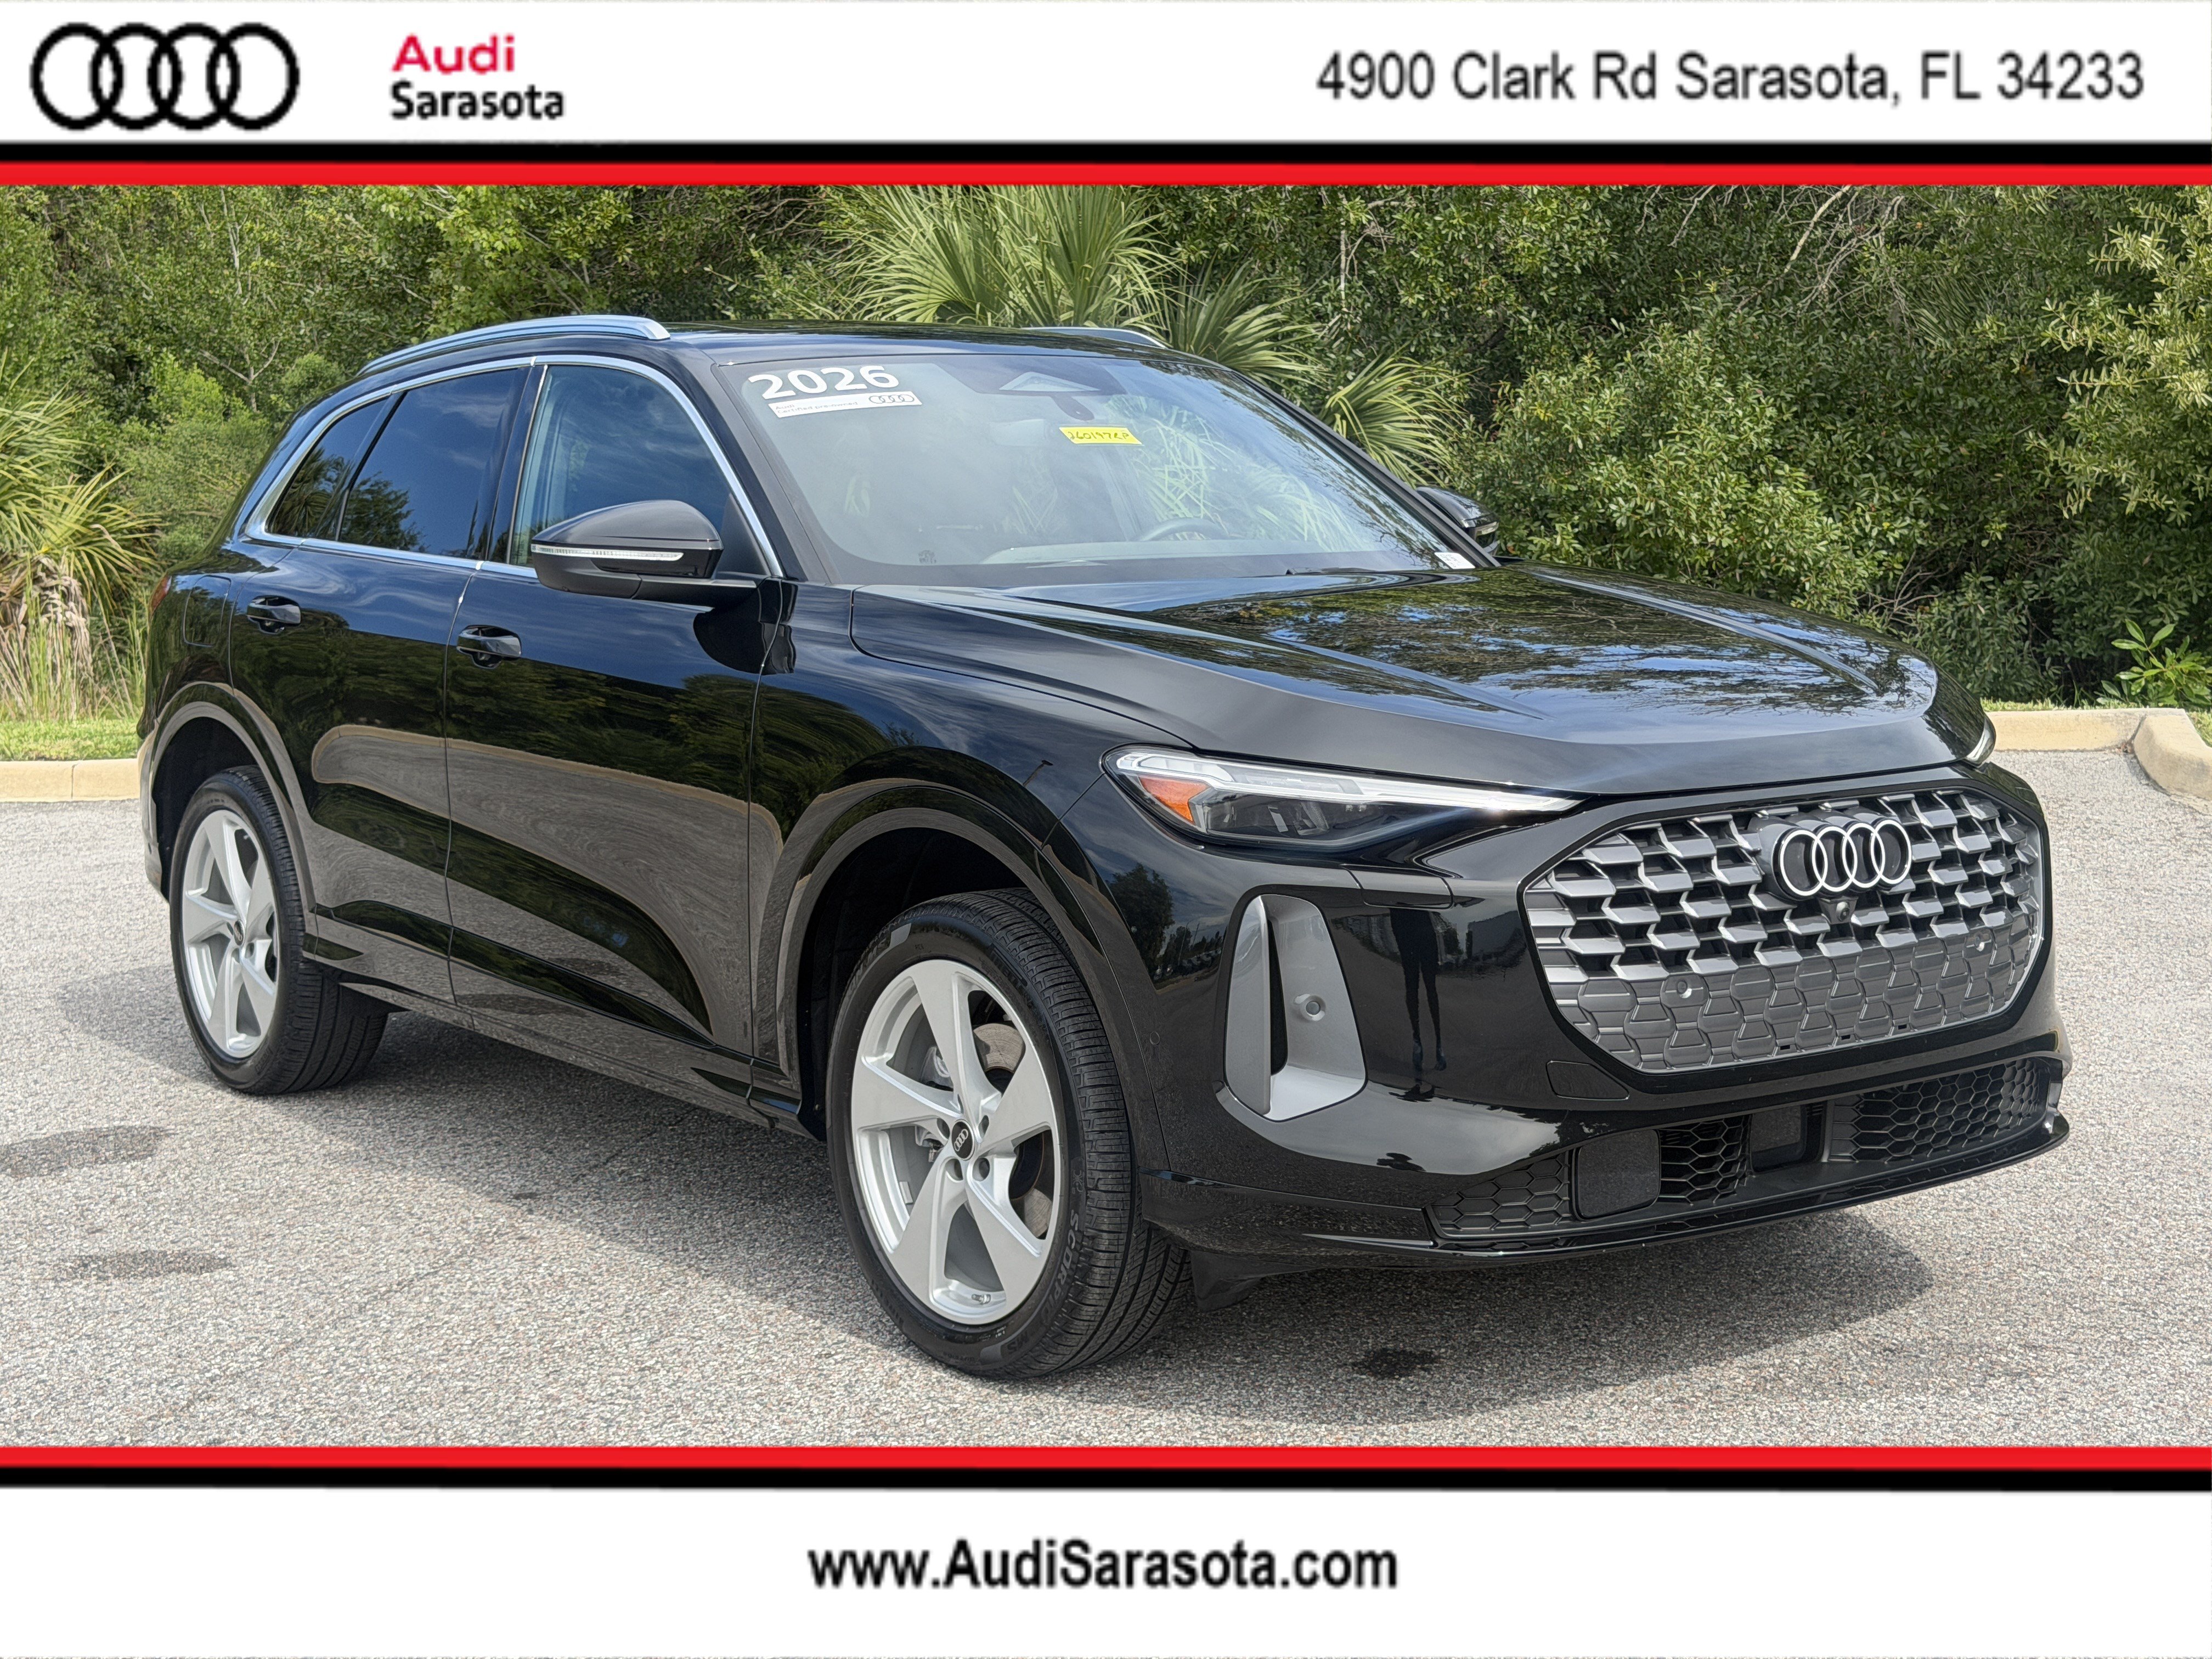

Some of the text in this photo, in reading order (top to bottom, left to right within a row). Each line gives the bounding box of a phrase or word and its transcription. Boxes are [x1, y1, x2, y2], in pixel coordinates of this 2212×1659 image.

[748, 365, 899, 399] 2026
[815, 402, 858, 410] pre-owned
[1040, 1209, 1079, 1325] SCORPIO
